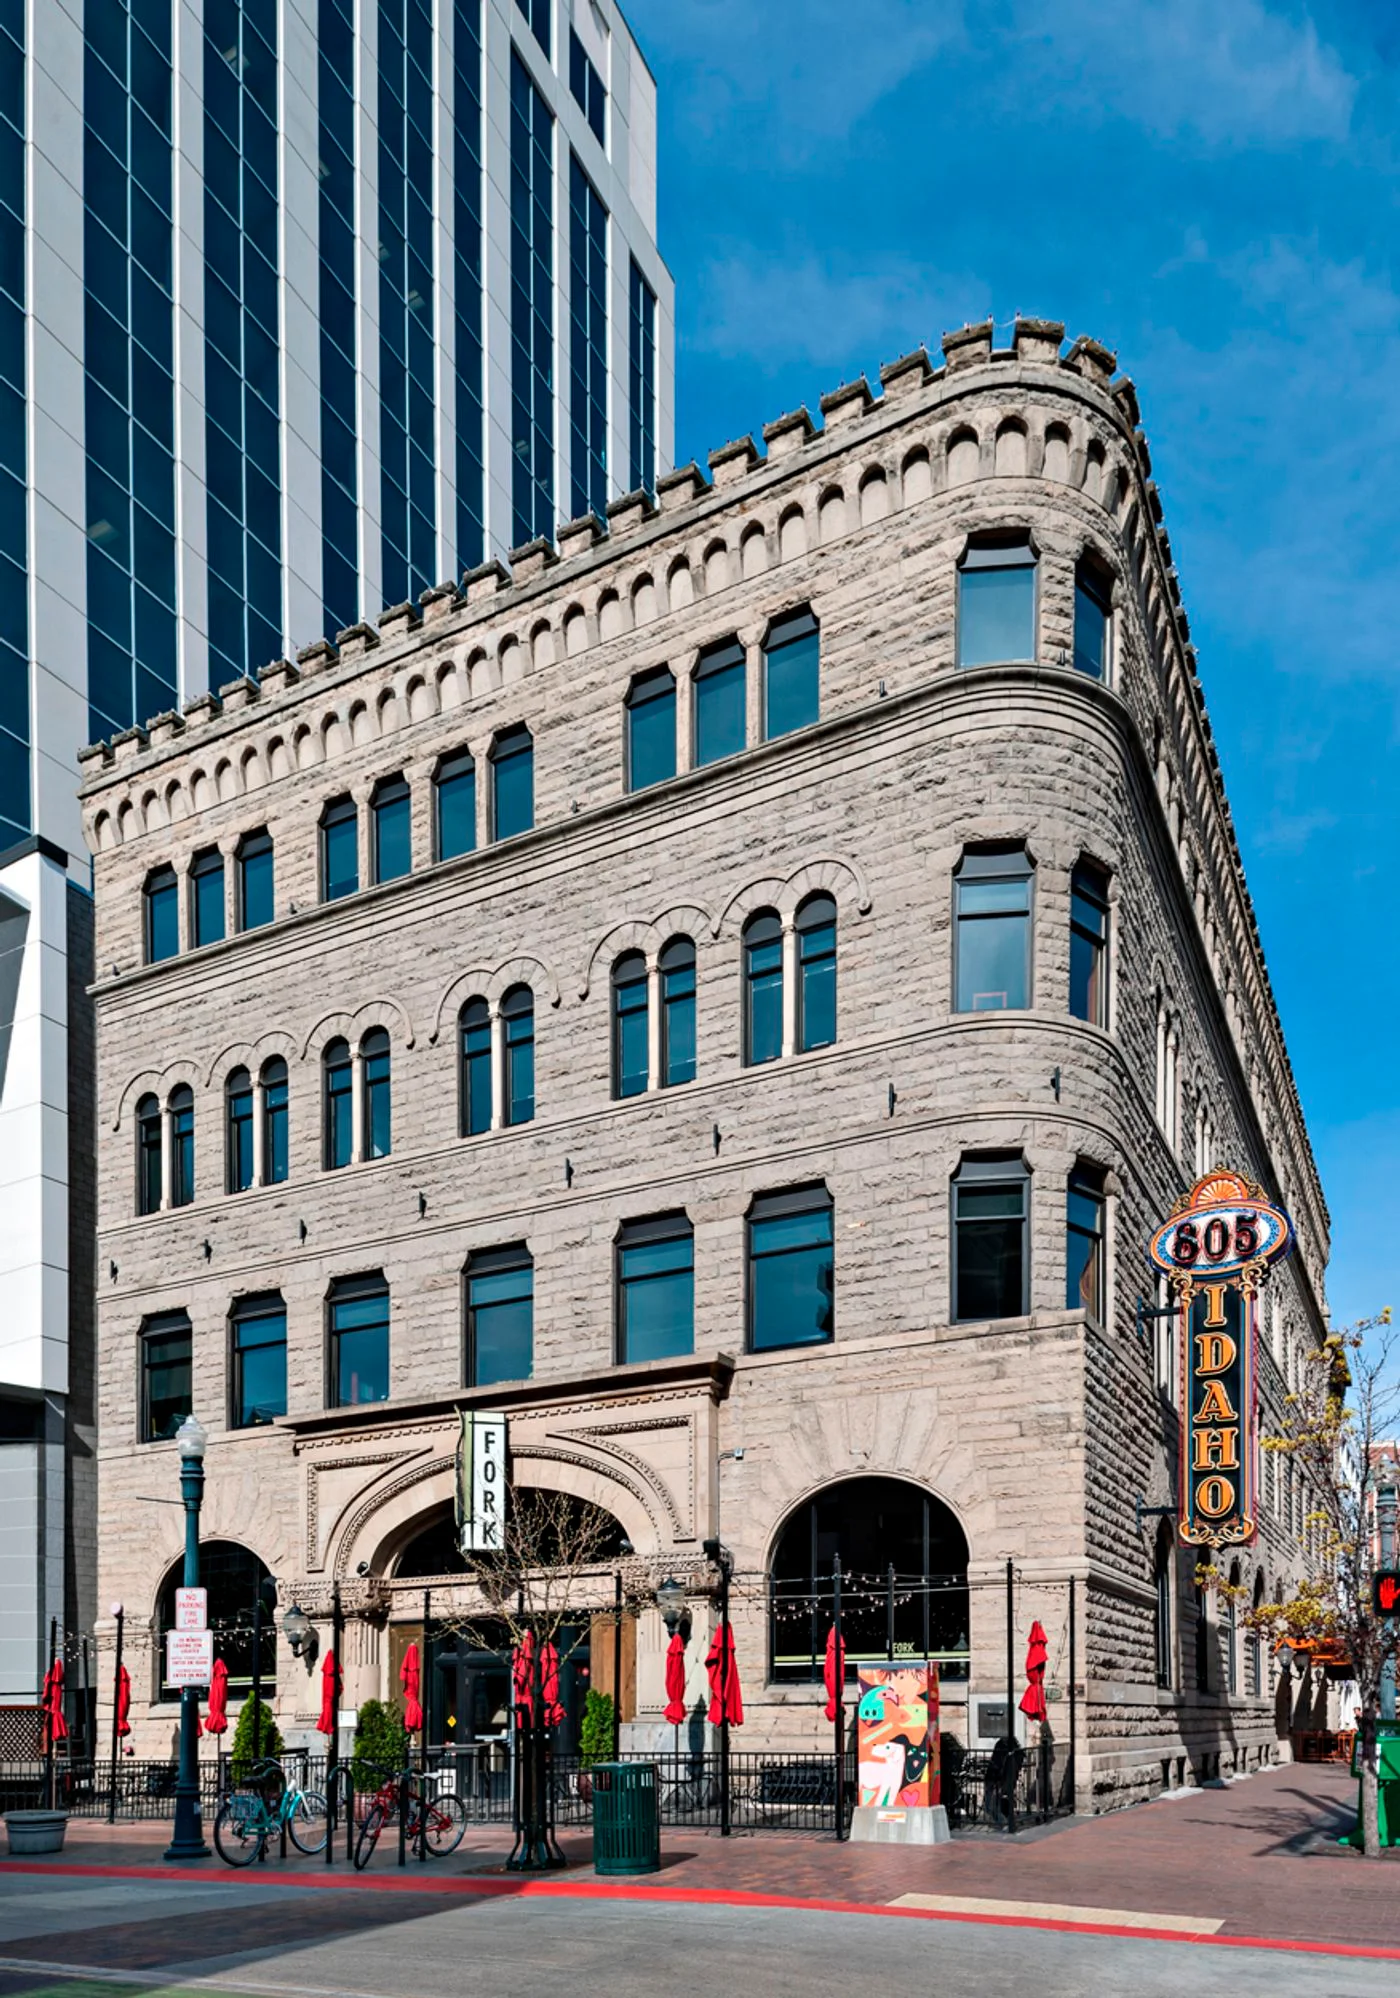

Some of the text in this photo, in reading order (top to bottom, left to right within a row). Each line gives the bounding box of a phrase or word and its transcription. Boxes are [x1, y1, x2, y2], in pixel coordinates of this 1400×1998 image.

[1172, 1211, 1259, 1265] 805
[1192, 1283, 1240, 1519] IDAHO
[483, 1430, 497, 1545] FORK
[185, 1593, 197, 1601] NO
[892, 1642, 915, 1653] FORK
